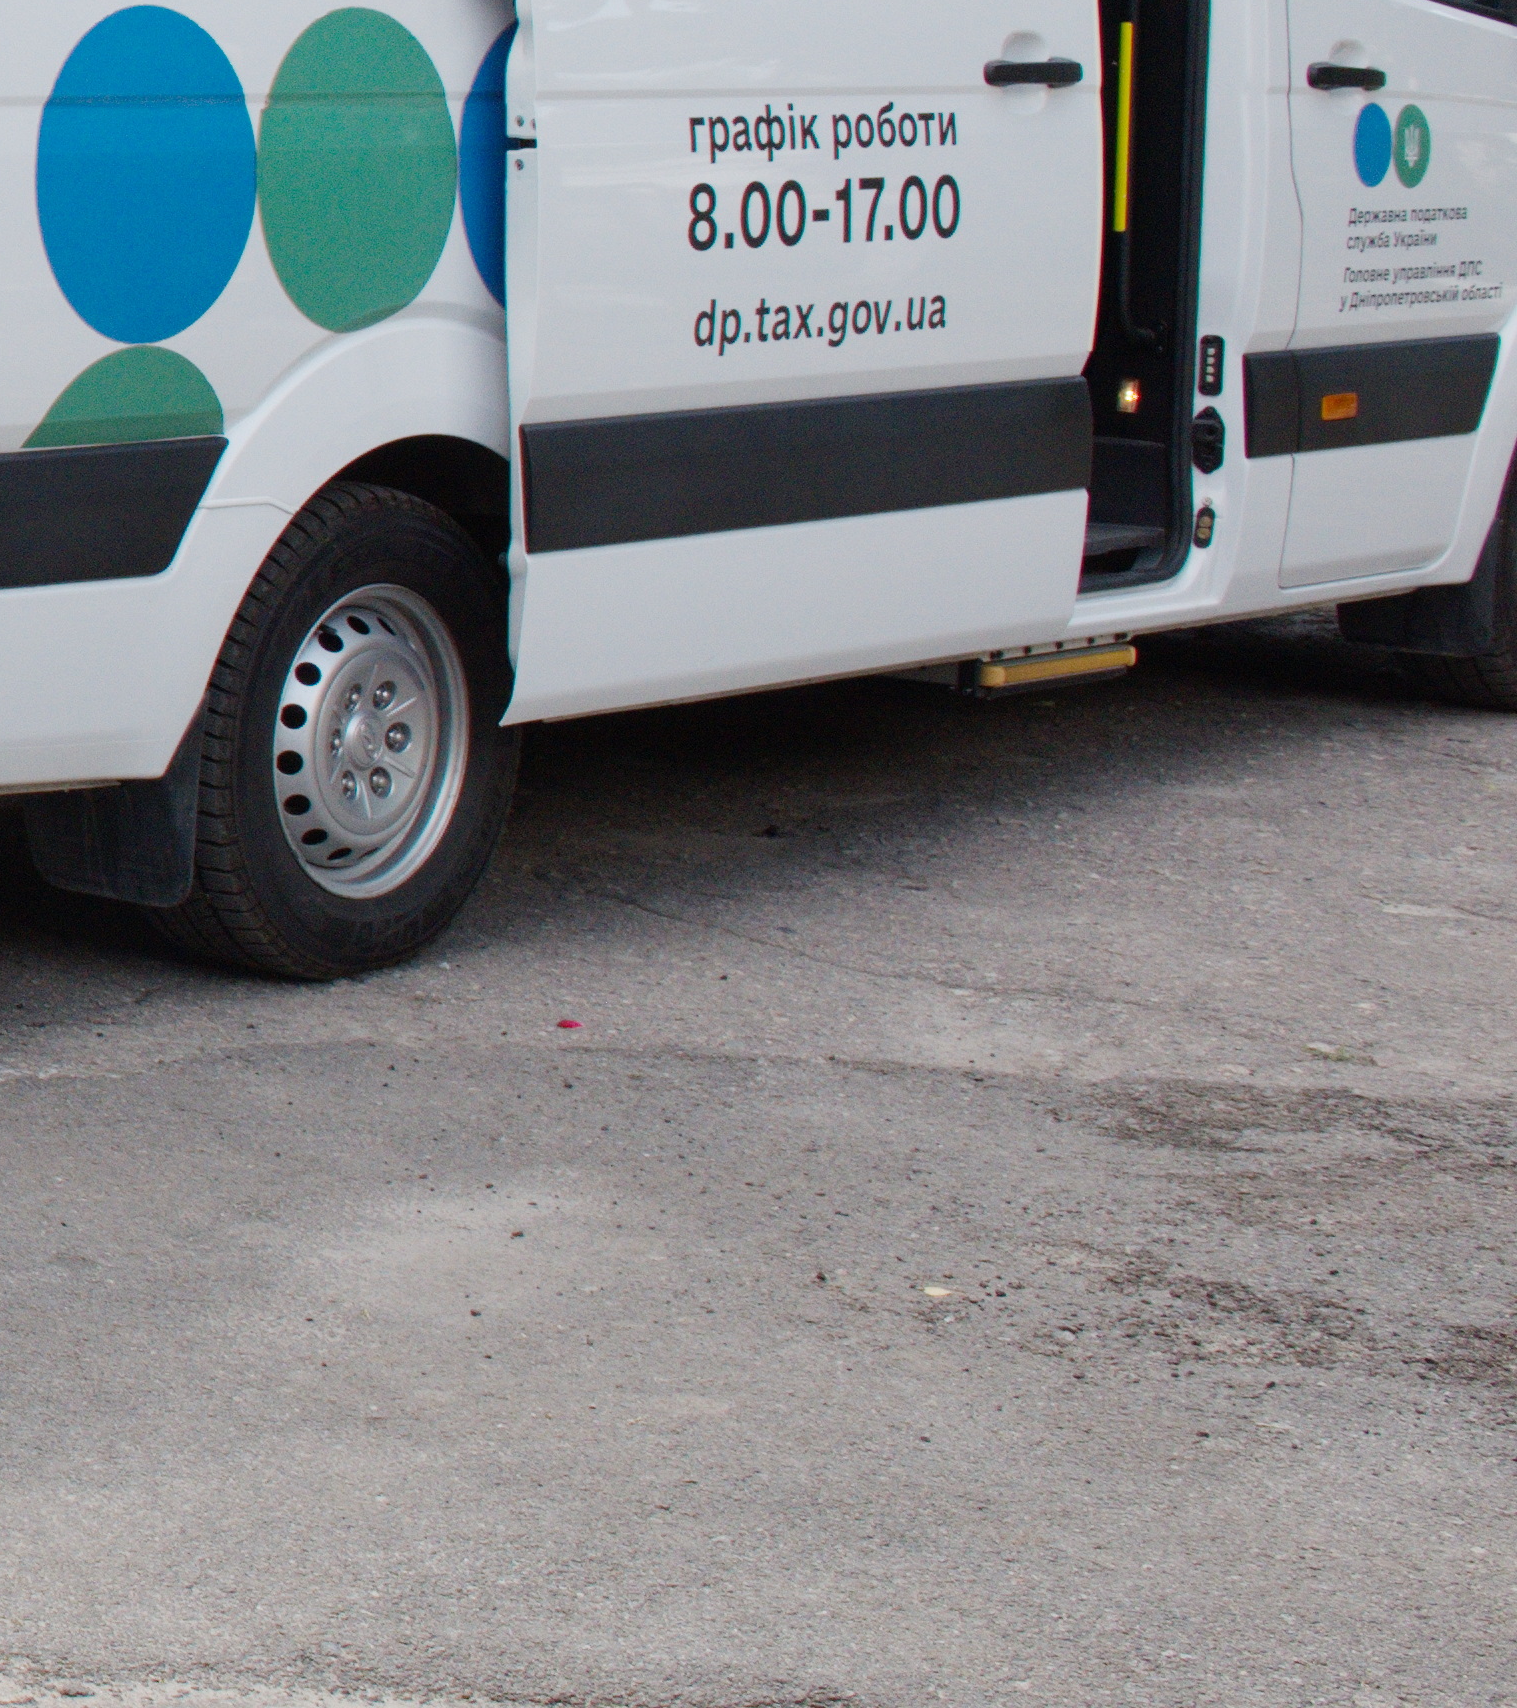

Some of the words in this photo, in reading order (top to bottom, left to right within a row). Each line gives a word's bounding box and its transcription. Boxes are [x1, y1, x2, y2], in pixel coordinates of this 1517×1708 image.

[688, 103, 820, 164] графік
[832, 101, 958, 160] роботи
[687, 173, 961, 252] 8.00-17.00
[1347, 206, 1407, 227] Державна
[1410, 206, 1468, 225] податкова
[1346, 231, 1391, 253] служба
[1393, 229, 1438, 250] України
[1343, 266, 1390, 283] Головне
[1392, 262, 1456, 285] управління
[1457, 259, 1483, 280] ДПС
[1338, 294, 1348, 313] у
[1348, 284, 1460, 311] Дніпропетровській
[1460, 282, 1504, 301] області
[693, 293, 947, 356] dp.tax.gov.ua
